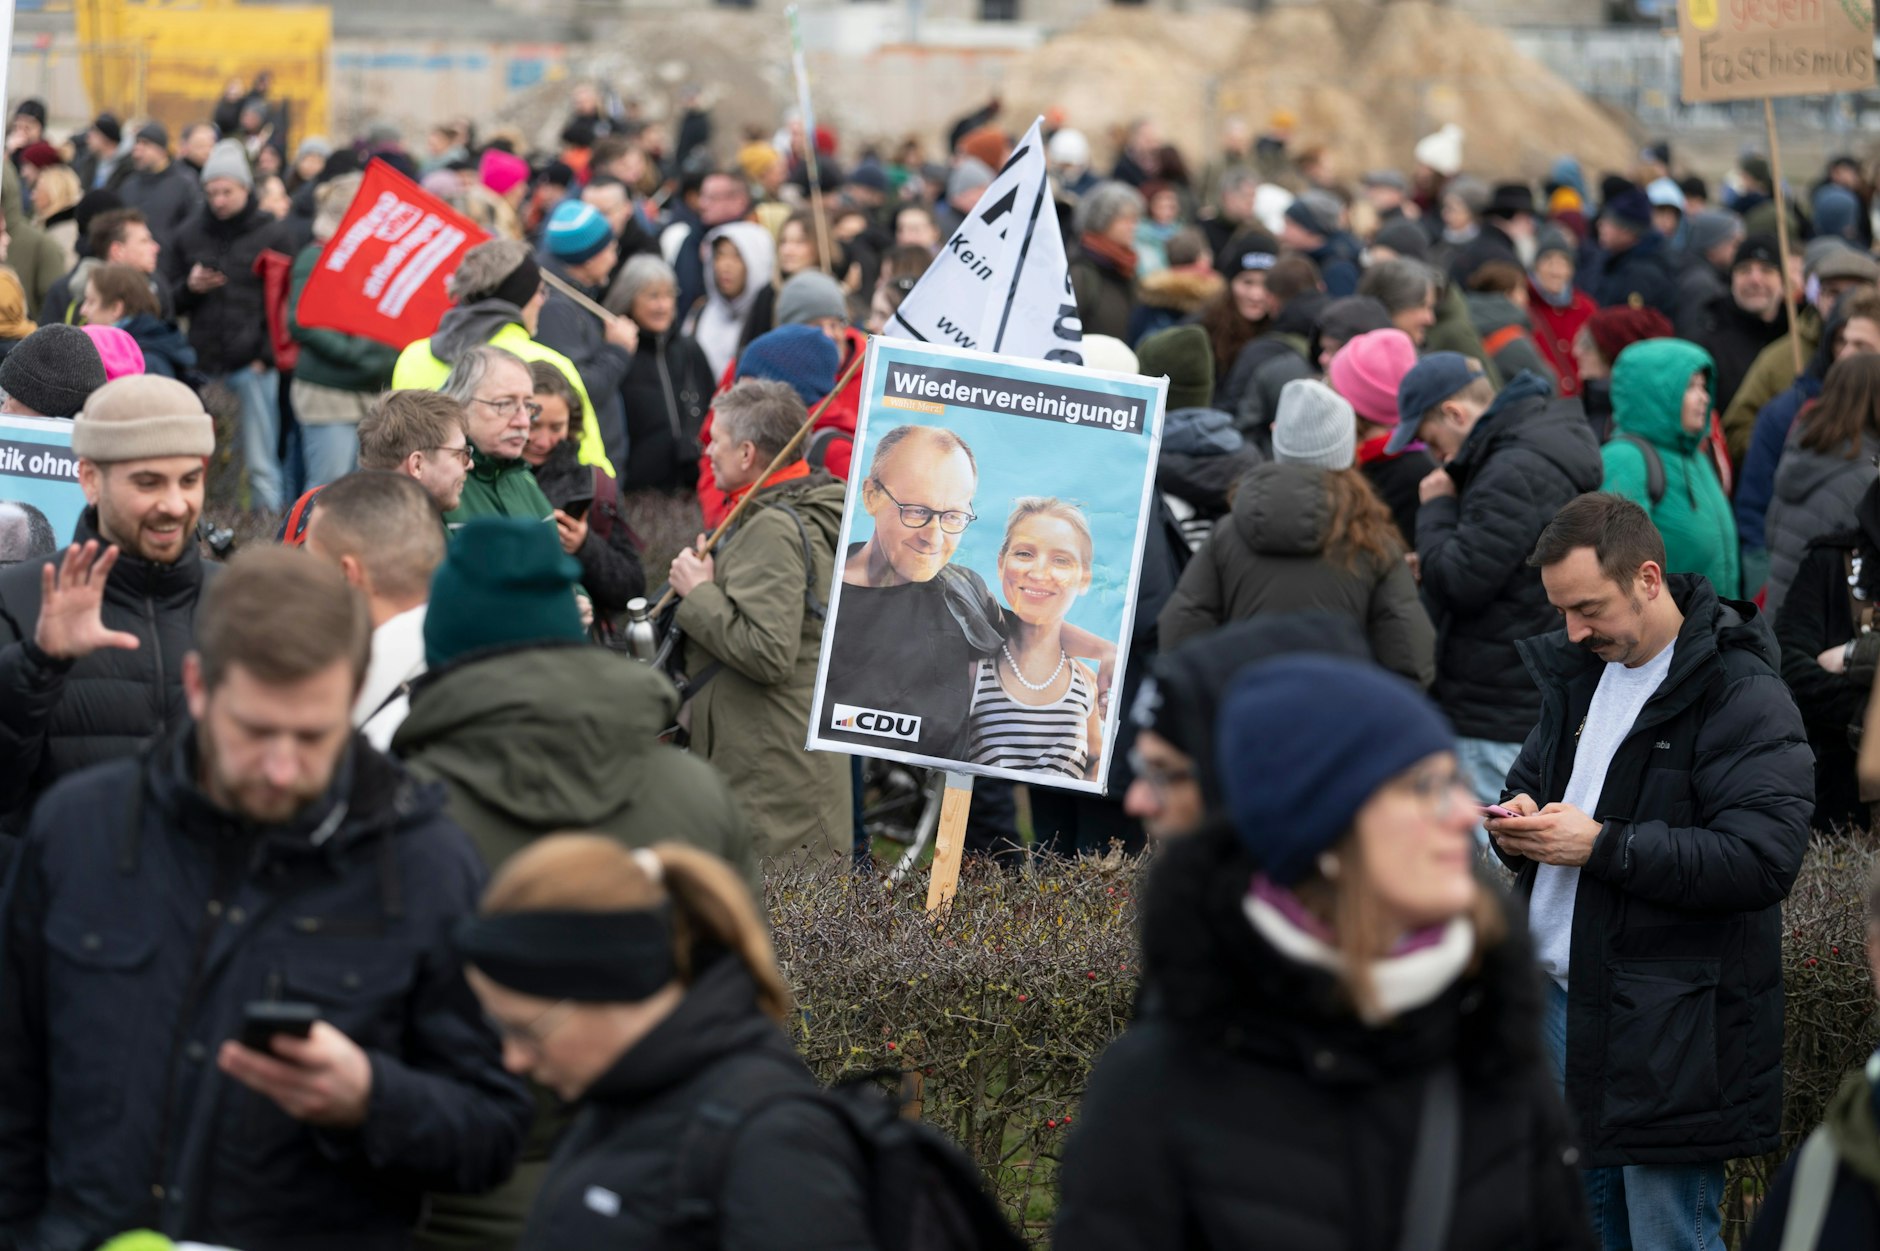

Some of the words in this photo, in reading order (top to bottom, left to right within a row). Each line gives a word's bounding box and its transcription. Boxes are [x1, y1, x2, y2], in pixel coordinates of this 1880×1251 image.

[1730, 0, 1818, 31] gegen
[1698, 31, 1870, 90] Faschismus
[950, 233, 993, 280] Kein
[936, 315, 977, 349] ww
[894, 371, 1138, 431] Wiedervereinigung!
[856, 712, 917, 736] CDU
